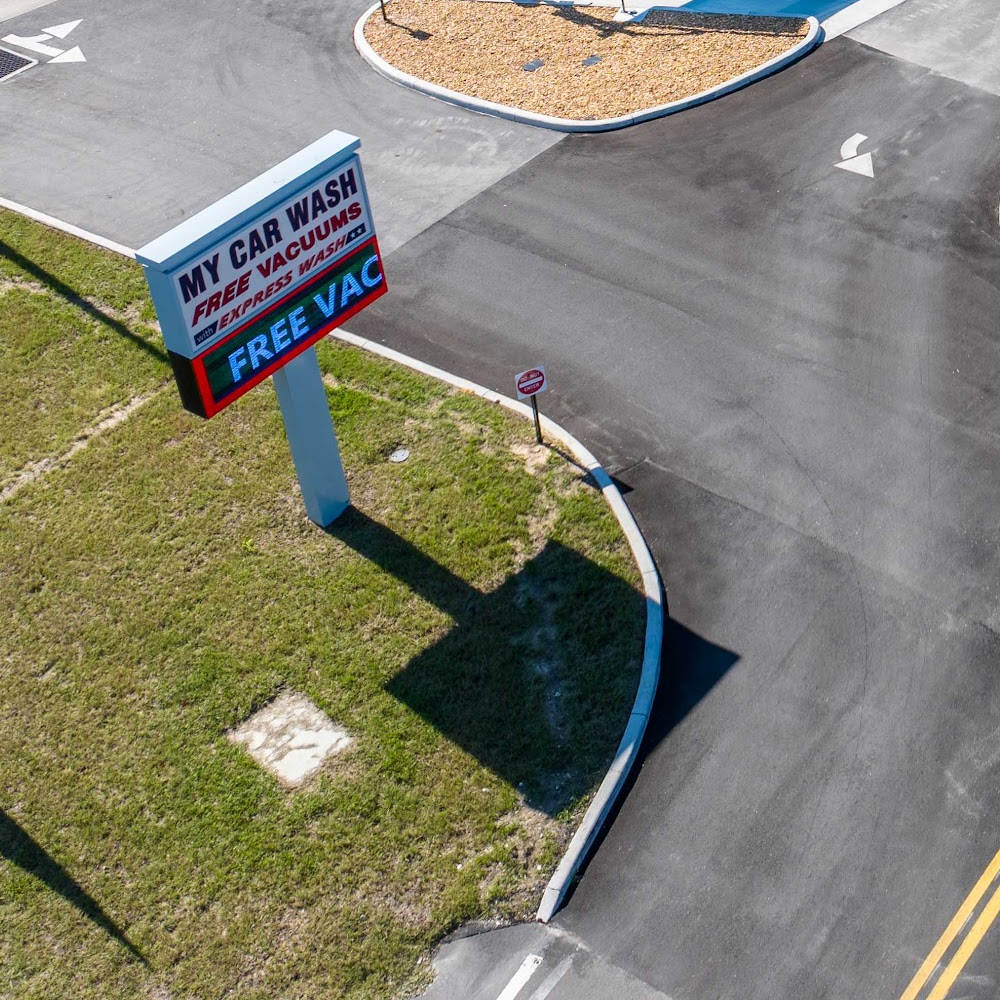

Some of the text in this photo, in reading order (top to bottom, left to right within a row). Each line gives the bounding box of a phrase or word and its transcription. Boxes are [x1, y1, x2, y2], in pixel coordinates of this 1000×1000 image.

[178, 167, 358, 304] MY CAR WASH
[191, 201, 362, 328] FREE VACUUMS
[196, 234, 348, 344] with EXPRESS WASH
[228, 254, 383, 383] FREE VAC
